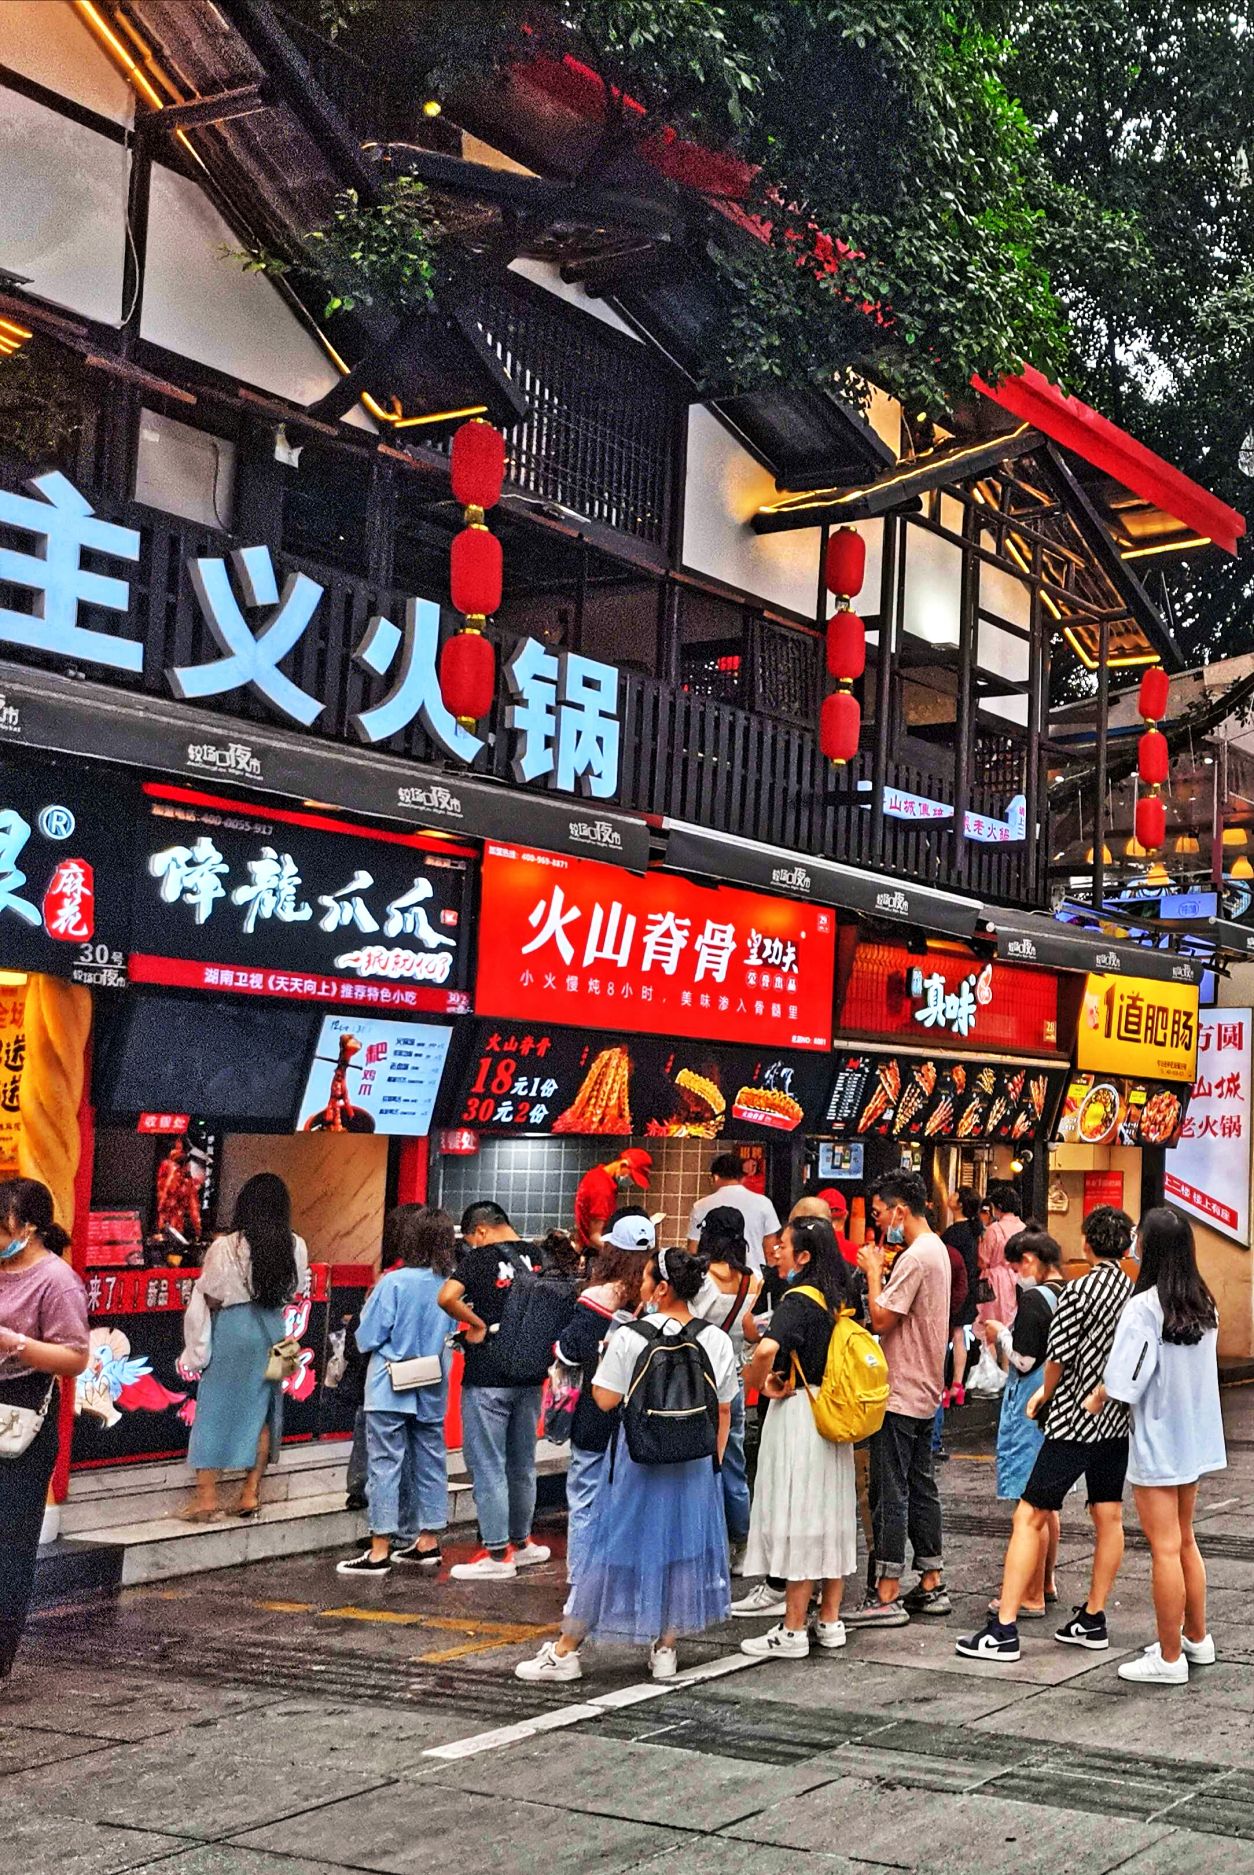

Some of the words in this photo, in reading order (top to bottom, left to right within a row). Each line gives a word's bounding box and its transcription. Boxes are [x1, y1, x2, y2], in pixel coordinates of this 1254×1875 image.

[0, 470, 621, 799] 主义火锅
[52, 862, 91, 935] 麻花
[80, 943, 124, 965] 30号
[521, 884, 738, 983] 火山脊骨
[915, 972, 977, 1037] 真味
[1104, 982, 1194, 1051] 1道肥肠
[485, 1033, 552, 1057] 火山脊骨
[1198, 1021, 1244, 1051] 方圆
[471, 1056, 559, 1097] 18元1份
[1190, 1072, 1245, 1101] 山城
[462, 1097, 549, 1124] 30元2份
